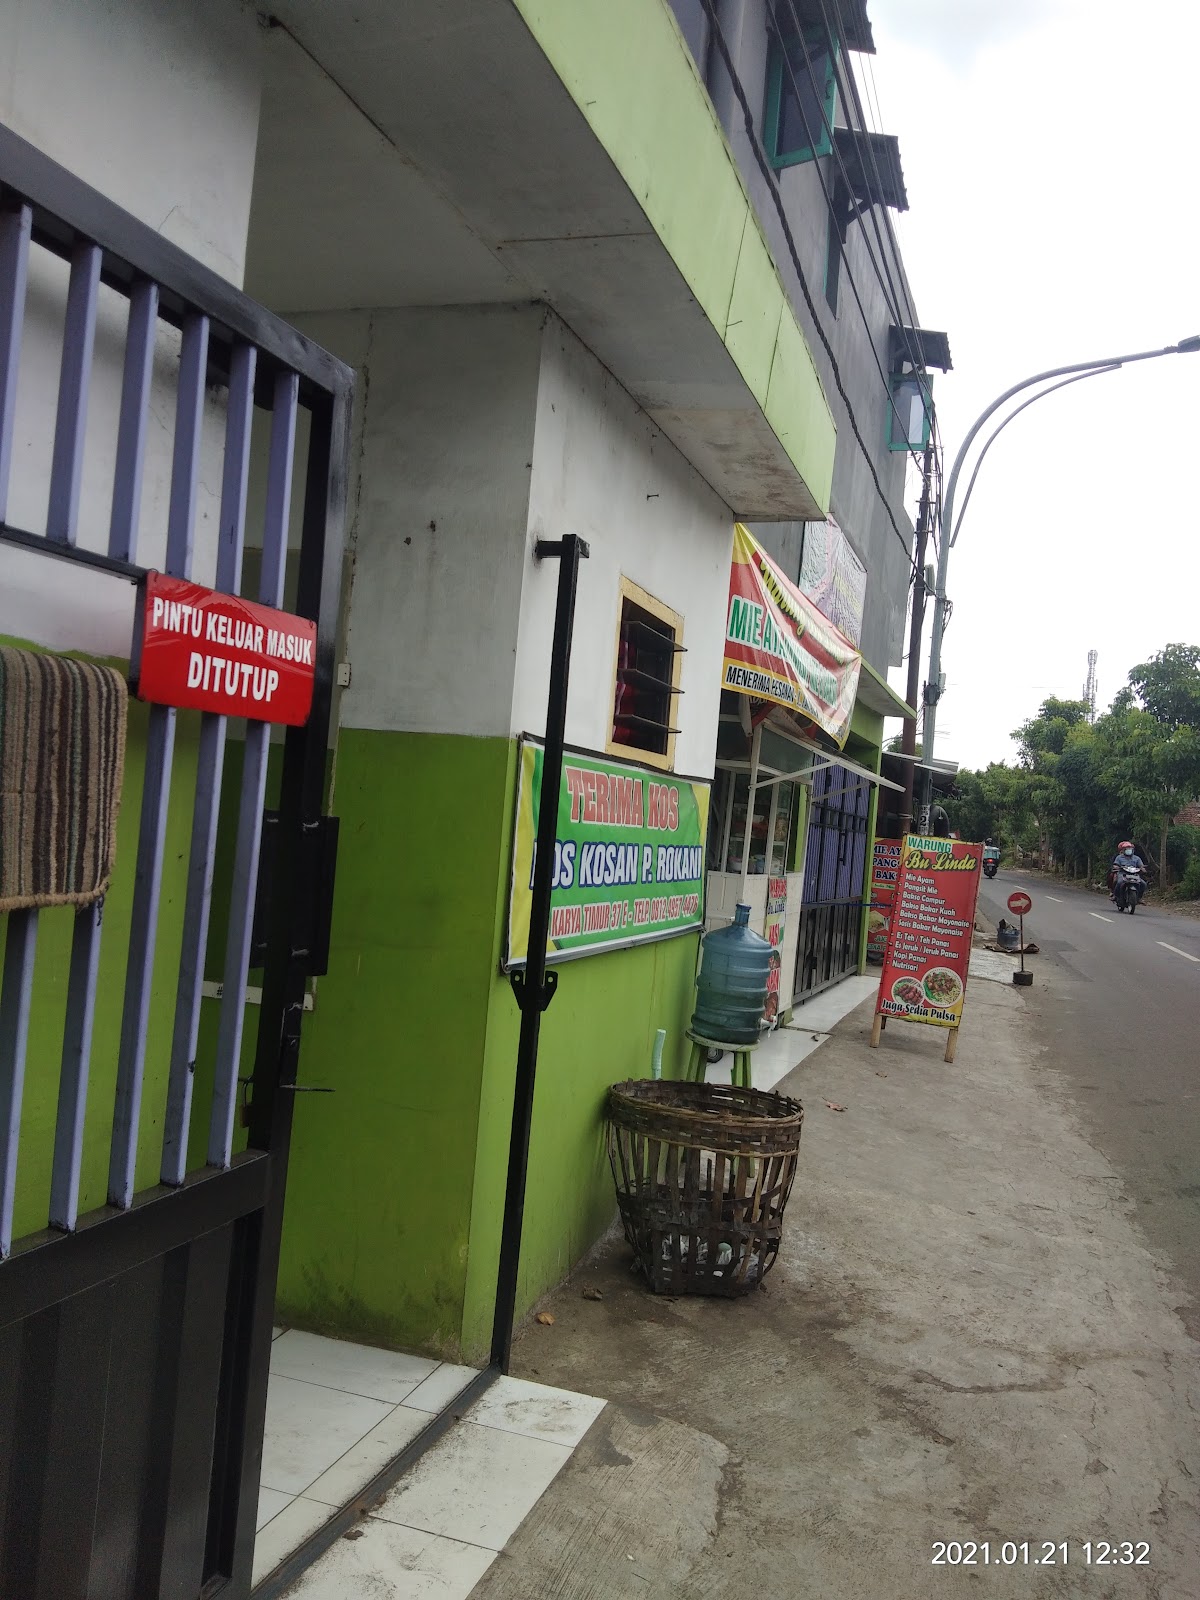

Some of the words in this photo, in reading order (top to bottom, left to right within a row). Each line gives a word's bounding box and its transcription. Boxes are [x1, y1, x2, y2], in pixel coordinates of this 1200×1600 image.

[728, 596, 763, 647] MIE
[152, 597, 203, 637] PINTU
[206, 612, 263, 653] KELUAR
[267, 629, 313, 665] MASUK
[187, 652, 278, 702] DITUTUP
[726, 664, 770, 693] MENERIMA
[565, 766, 643, 827] TERIMA
[648, 782, 679, 831] KOS
[908, 836, 952, 853] WARUNG
[530, 840, 576, 889] OS
[579, 842, 638, 888] KOSAN
[641, 843, 653, 884] P.
[656, 845, 702, 882] ROKANI
[873, 858, 900, 868] PANG
[905, 850, 930, 869] Bu
[932, 852, 976, 870] Linda
[876, 870, 898, 880] BAK
[906, 873, 917, 881] Mie
[918, 875, 935, 885] Ayam
[905, 882, 927, 893] Pangsit
[928, 886, 938, 894] Mie
[904, 891, 920, 901] Bakso
[922, 895, 945, 905] Campur
[902, 900, 919, 910] Bakso
[921, 904, 938, 914] Bakar
[940, 908, 956, 916] Kuah
[551, 904, 582, 938] KARYA
[583, 901, 611, 934] TIMUR
[611, 901, 622, 930] 37
[621, 900, 629, 928] E
[650, 897, 667, 923] 0812
[901, 909, 918, 919] Bakso
[919, 913, 937, 922] Bakar
[939, 916, 970, 928] Mayonaise
[913, 922, 931, 931] Bakar
[932, 925, 964, 937] Mayonaise
[897, 931, 902, 939] Es
[905, 933, 914, 941] Teh
[920, 935, 931, 944] Teh
[933, 938, 950, 948] Panas
[894, 950, 907, 961] Kopi
[909, 953, 927, 963] Panas
[903, 942, 918, 951] Jeruk
[924, 946, 939, 956] Jeruk
[941, 948, 959, 959] Panas
[893, 959, 919, 972] Nutrisari
[905, 1003, 928, 1017] Sedia
[931, 1008, 956, 1022] Pulsa
